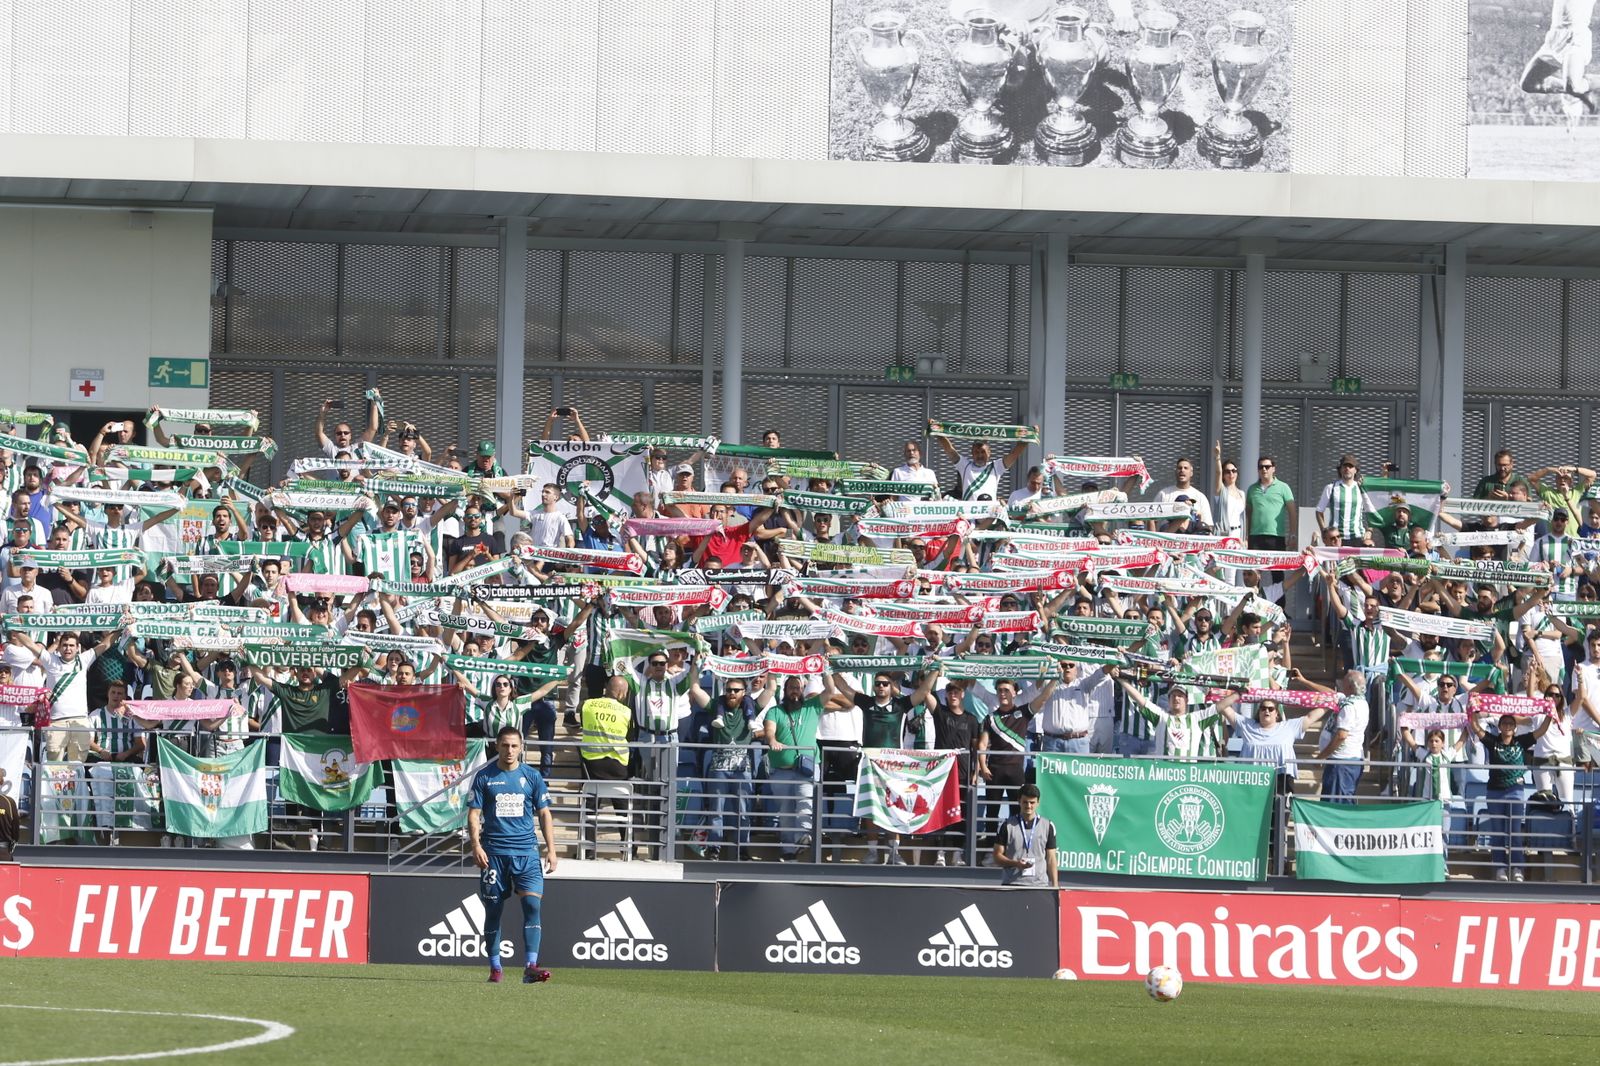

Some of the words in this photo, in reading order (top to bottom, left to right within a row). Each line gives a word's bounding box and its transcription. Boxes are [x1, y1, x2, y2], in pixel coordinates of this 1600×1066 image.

[241, 439, 258, 447] CF
[534, 586, 581, 597] HOOLIGANS
[95, 616, 115, 626] CF
[1125, 625, 1142, 635] CF
[248, 650, 360, 668] VOLVEREMOS
[900, 657, 918, 666] CF
[3, 687, 36, 696] MUJER
[1255, 689, 1290, 698] MUJER
[1502, 697, 1534, 706] MUJER
[1489, 704, 1544, 714] CORDOBESA
[595, 711, 617, 723] 1070
[1106, 850, 1125, 871] CF
[69, 884, 157, 954] FLY
[169, 886, 354, 958] BETTER
[1077, 906, 1419, 981] Emirates
[572, 937, 668, 962] adidas
[765, 940, 861, 965] adidas
[1452, 915, 1536, 985] FLY
[918, 943, 1013, 969] adidas
